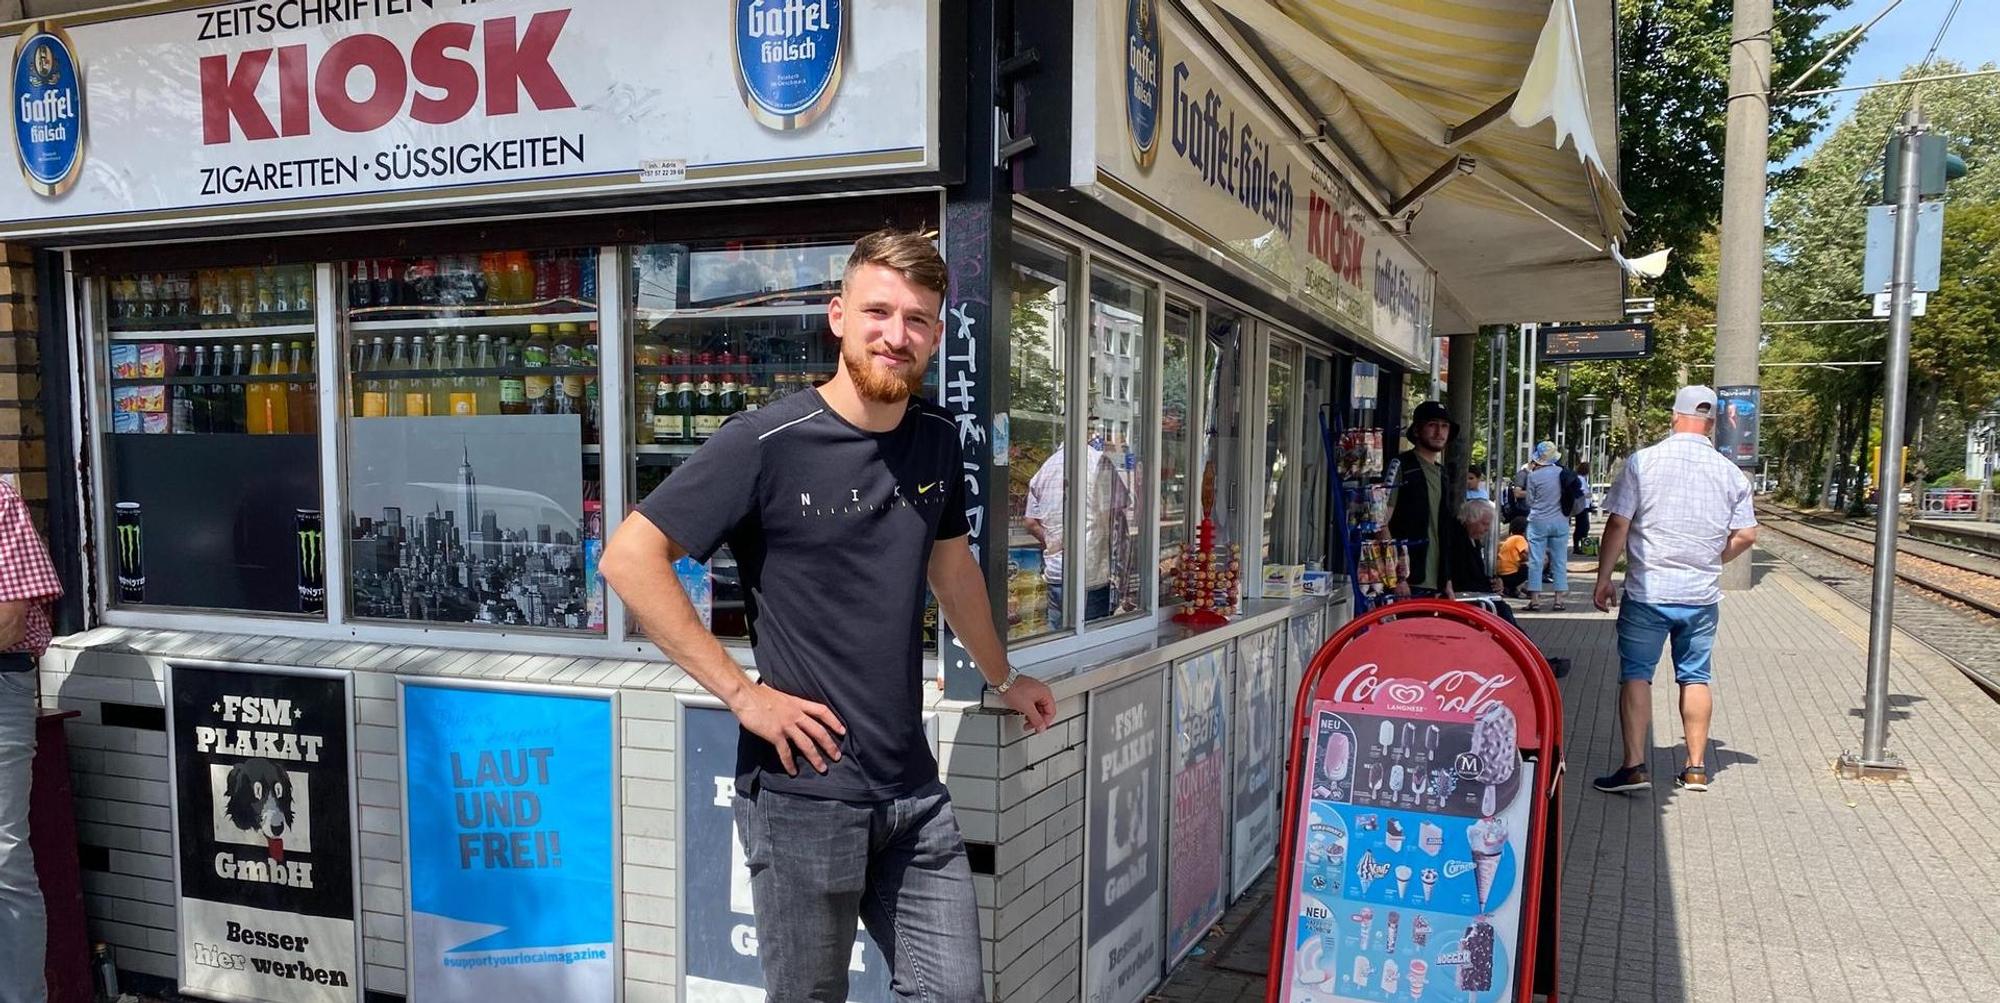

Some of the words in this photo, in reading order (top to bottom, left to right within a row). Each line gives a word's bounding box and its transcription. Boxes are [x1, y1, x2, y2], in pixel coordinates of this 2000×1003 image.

[748, 0, 831, 38] Gaffel
[761, 37, 816, 64] Kölsch
[1130, 35, 1157, 88] Gaffel
[202, 8, 577, 146] KIOSK
[21, 87, 74, 124] Gaffel
[31, 123, 66, 143] Kölsch
[200, 155, 359, 195] ZIGARETTEN
[373, 133, 585, 182] SÜSSIGKEITEN
[1307, 189, 1366, 291] KIOSK
[222, 694, 293, 727] FSM
[1114, 702, 1144, 742] FSM
[1320, 718, 1341, 730] NEU
[1386, 703, 1425, 713] LANGNESE
[196, 726, 323, 763] PLAKAT
[1101, 728, 1155, 784] PLAKAT
[451, 747, 555, 789] LAUT
[457, 791, 542, 829] UND
[458, 831, 564, 870] FREI!
[214, 852, 314, 890] GmbH
[1105, 852, 1148, 906] GmbH
[1305, 906, 1328, 919] NEU
[226, 921, 310, 952] Besser
[193, 942, 247, 972] hier
[251, 956, 349, 988] werben
[443, 948, 607, 969] #supportyourlocalmagazine
